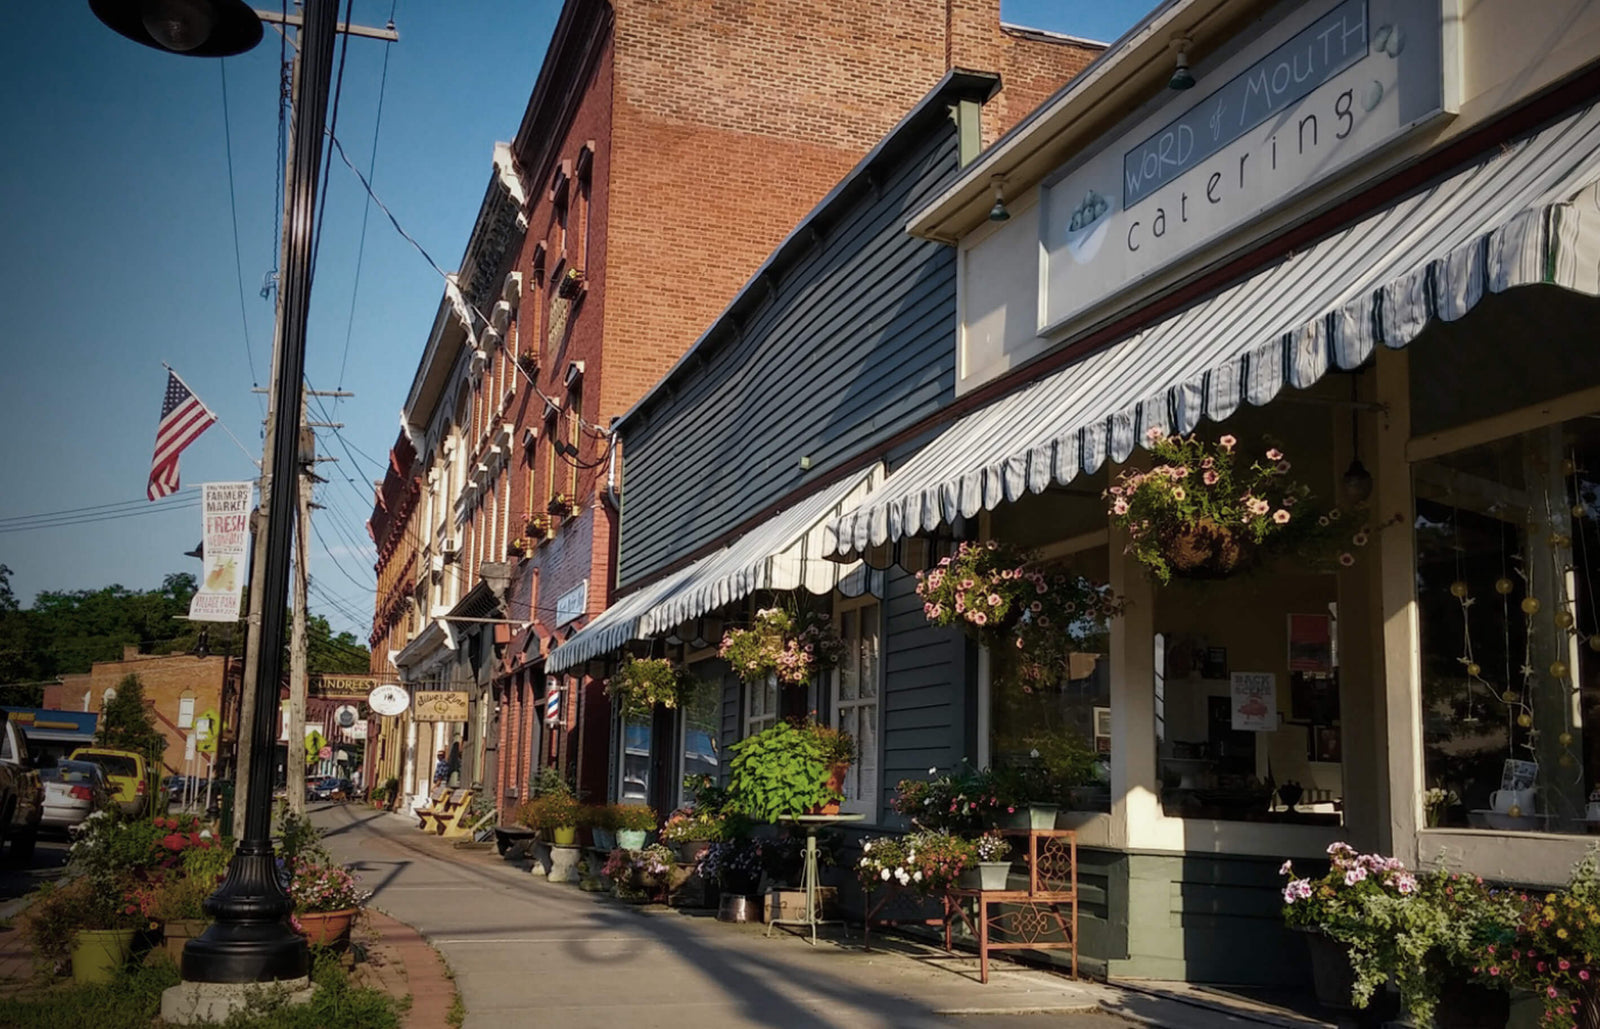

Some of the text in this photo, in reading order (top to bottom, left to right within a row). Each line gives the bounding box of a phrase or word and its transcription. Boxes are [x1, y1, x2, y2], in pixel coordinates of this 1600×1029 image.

[1125, 1, 1368, 197] WORD of MOUTH
[1127, 88, 1353, 253] catering
[206, 501, 249, 513] MARKET
[206, 515, 246, 533] FRESH
[417, 694, 444, 708] Silver
[444, 693, 466, 708] Line
